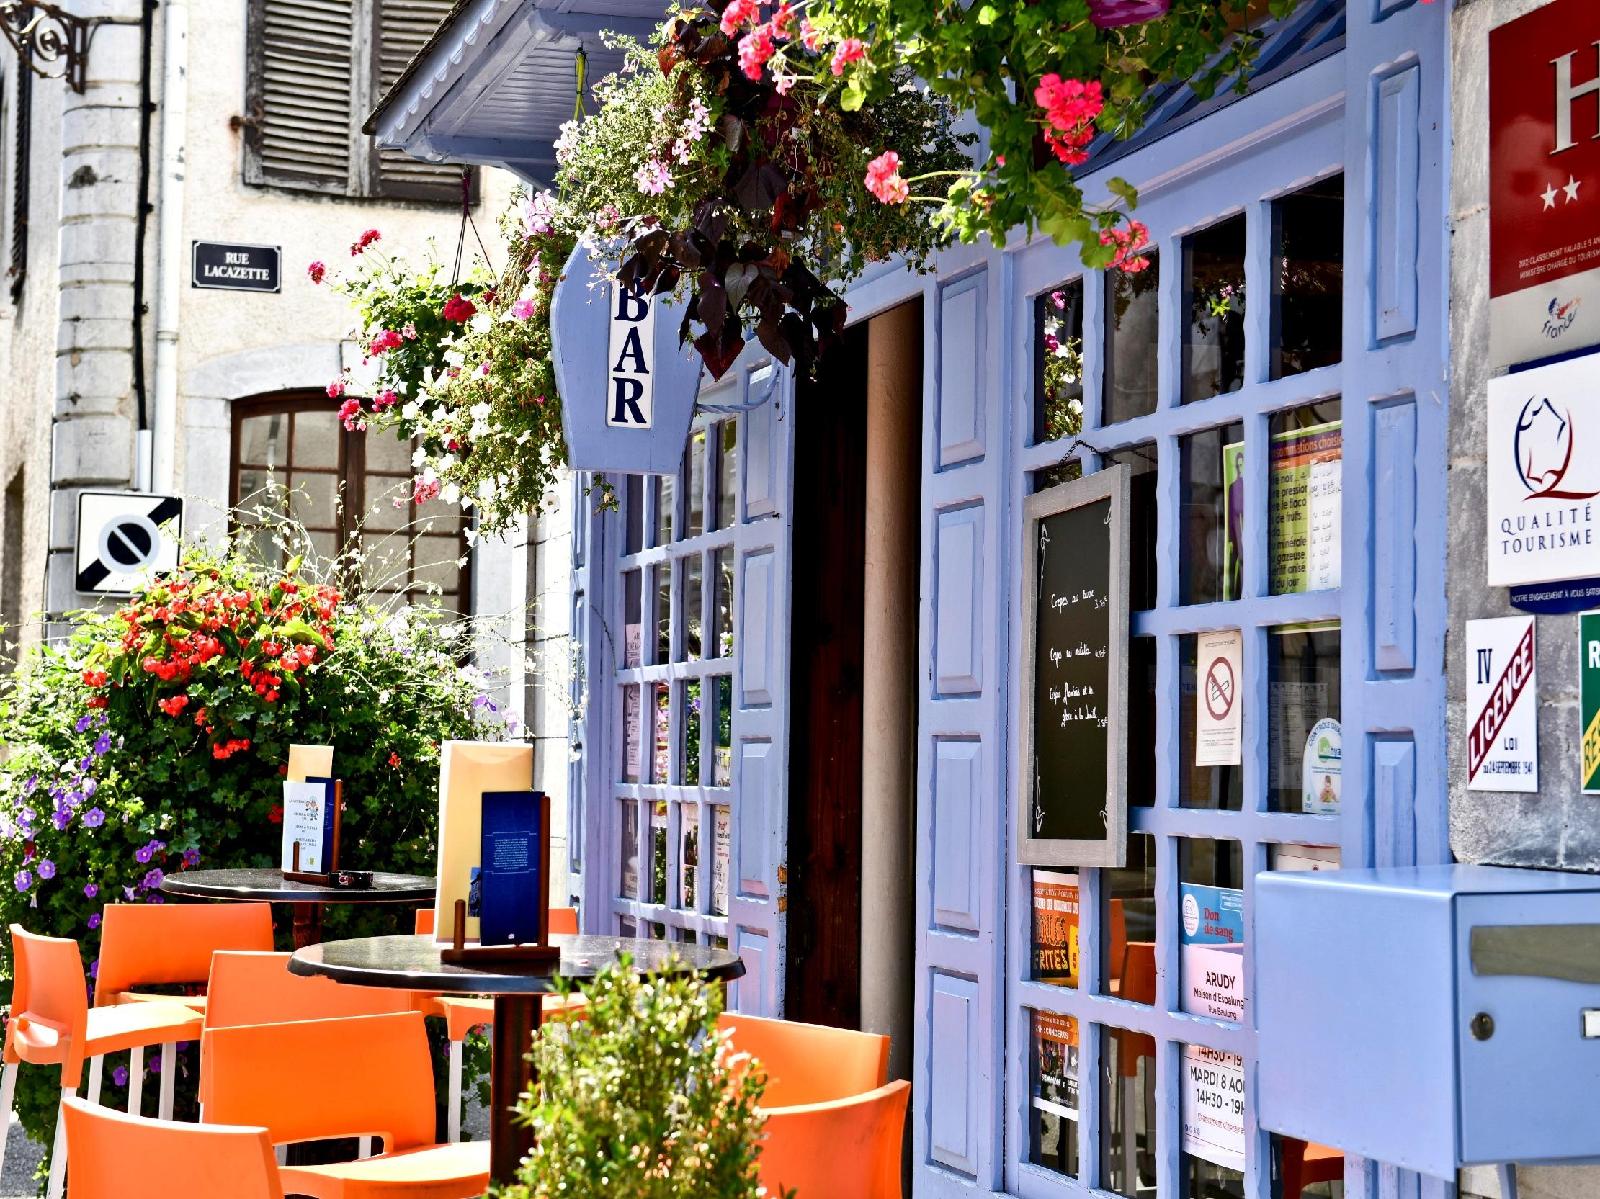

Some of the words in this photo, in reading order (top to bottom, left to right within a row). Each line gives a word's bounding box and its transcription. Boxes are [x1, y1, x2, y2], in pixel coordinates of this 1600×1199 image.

[1549, 40, 1600, 154] H
[225, 252, 249, 265] RUE
[1530, 248, 1562, 264] CLASSEMENT
[1564, 240, 1587, 253] VALABLE
[204, 265, 270, 280] LACAZETTE
[612, 278, 650, 424] BAR
[1501, 502, 1591, 536] QUALITÉ
[1502, 529, 1591, 555] TOURISME
[1277, 551, 1305, 564] gazeuse
[1511, 594, 1528, 603] NOTRE
[1528, 590, 1564, 602] ENGAGEMENT
[1570, 589, 1584, 598] VOUS
[1477, 648, 1493, 684] IV
[1470, 633, 1531, 771] LICENCE
[1503, 737, 1518, 750] LOI
[1495, 761, 1521, 774] SEPTEMBRE
[1204, 908, 1220, 921] Don
[1204, 923, 1214, 935] de
[1215, 927, 1233, 943] sang
[1206, 971, 1236, 989] ARUDY
[1193, 987, 1212, 1000] Maison
[1190, 1065, 1219, 1087] MARDI
[1221, 1075, 1226, 1089] 8
[1196, 1088, 1223, 1109] 14H30
